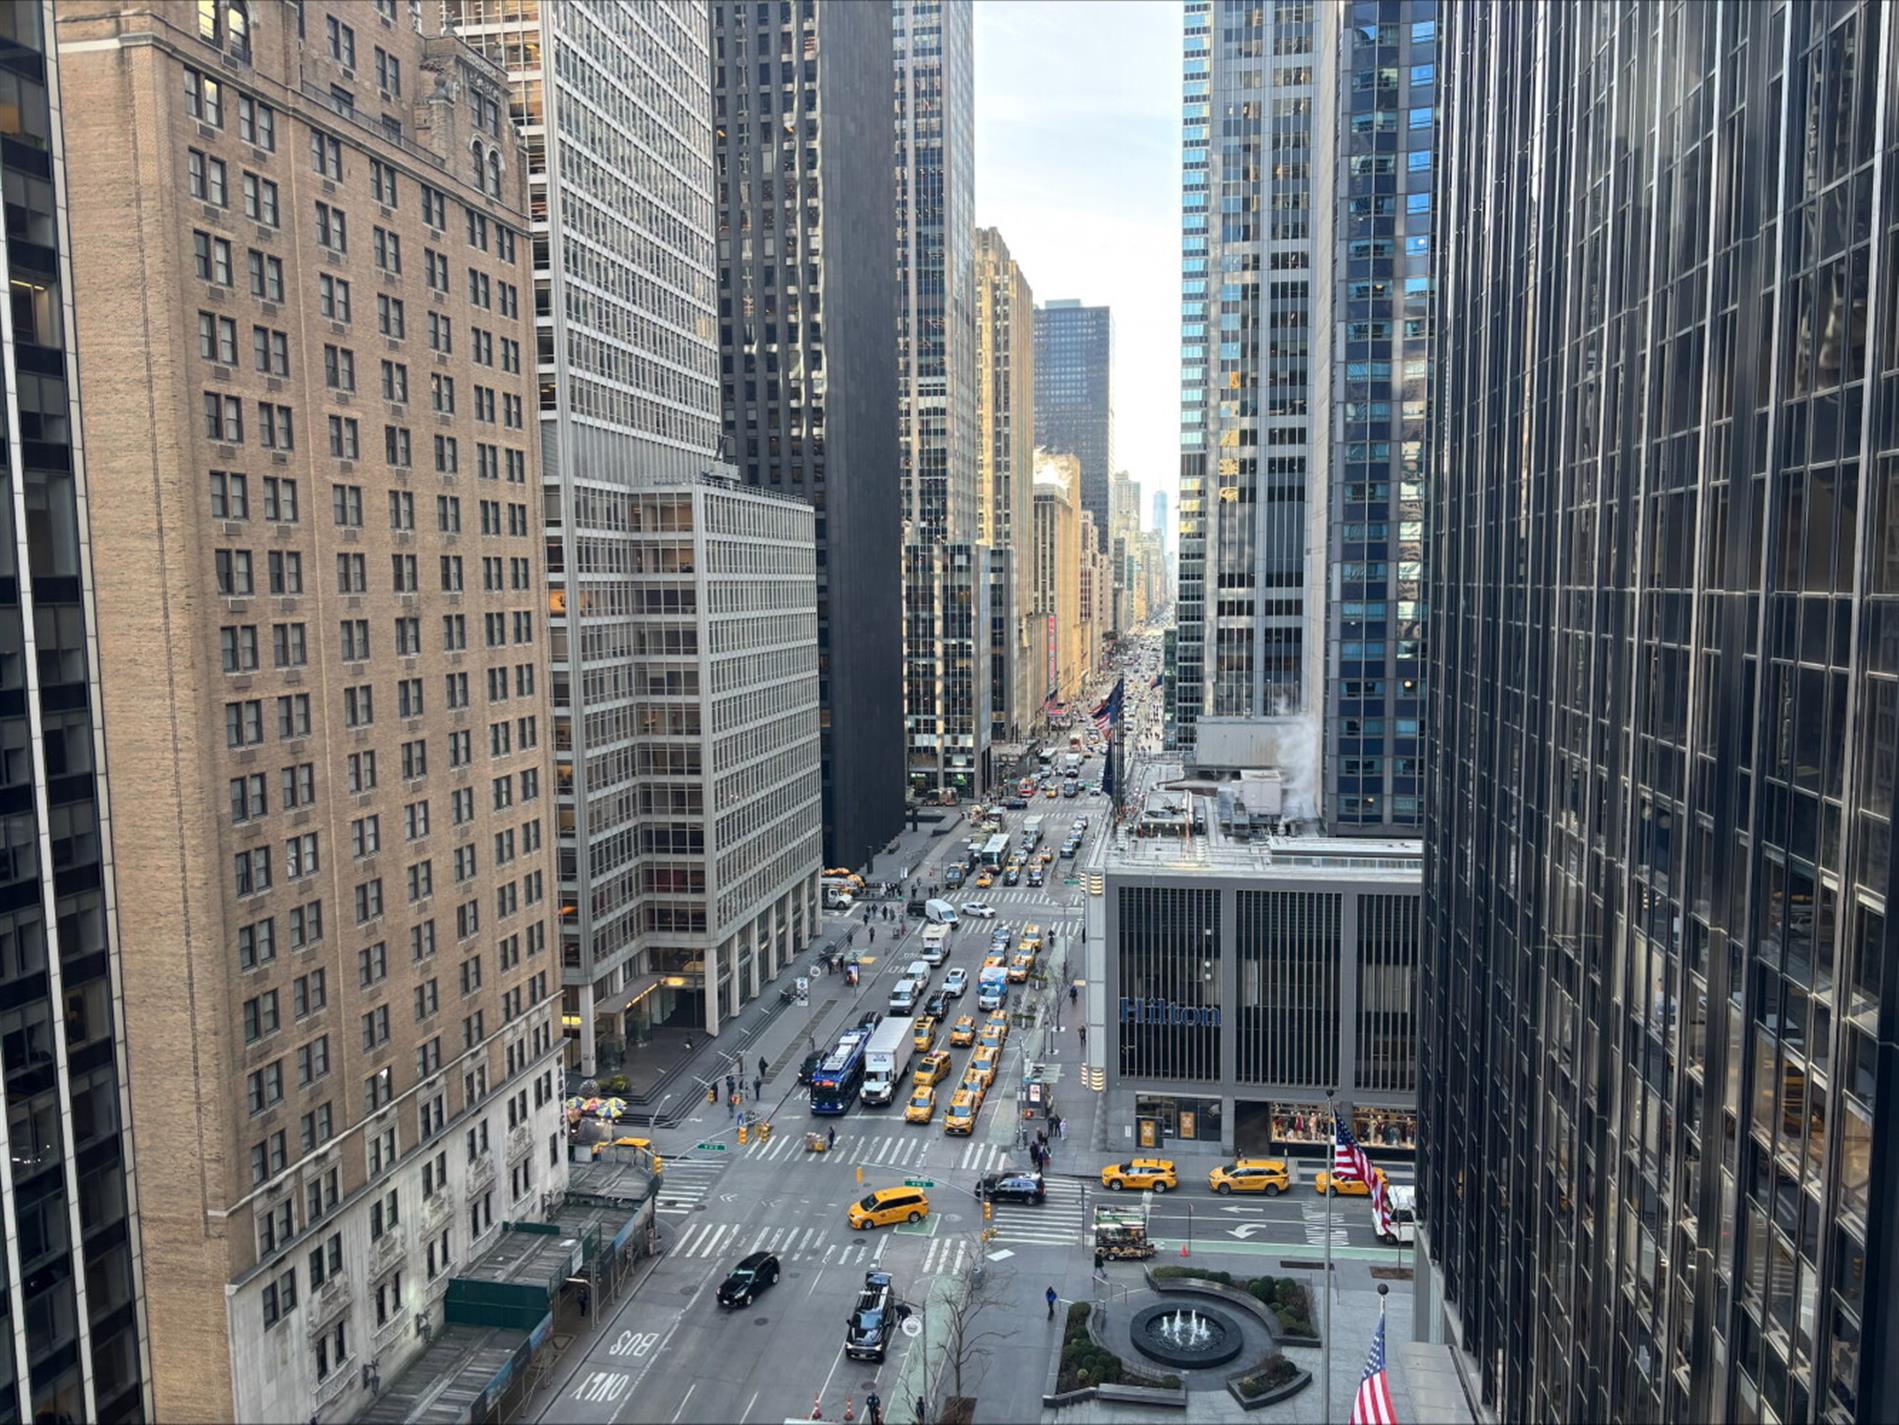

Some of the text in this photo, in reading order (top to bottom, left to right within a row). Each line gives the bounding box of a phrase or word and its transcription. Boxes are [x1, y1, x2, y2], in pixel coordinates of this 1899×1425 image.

[1119, 996, 1222, 1027] Hilton
[609, 1329, 660, 1357] BUS
[569, 1371, 630, 1402] ONLY
